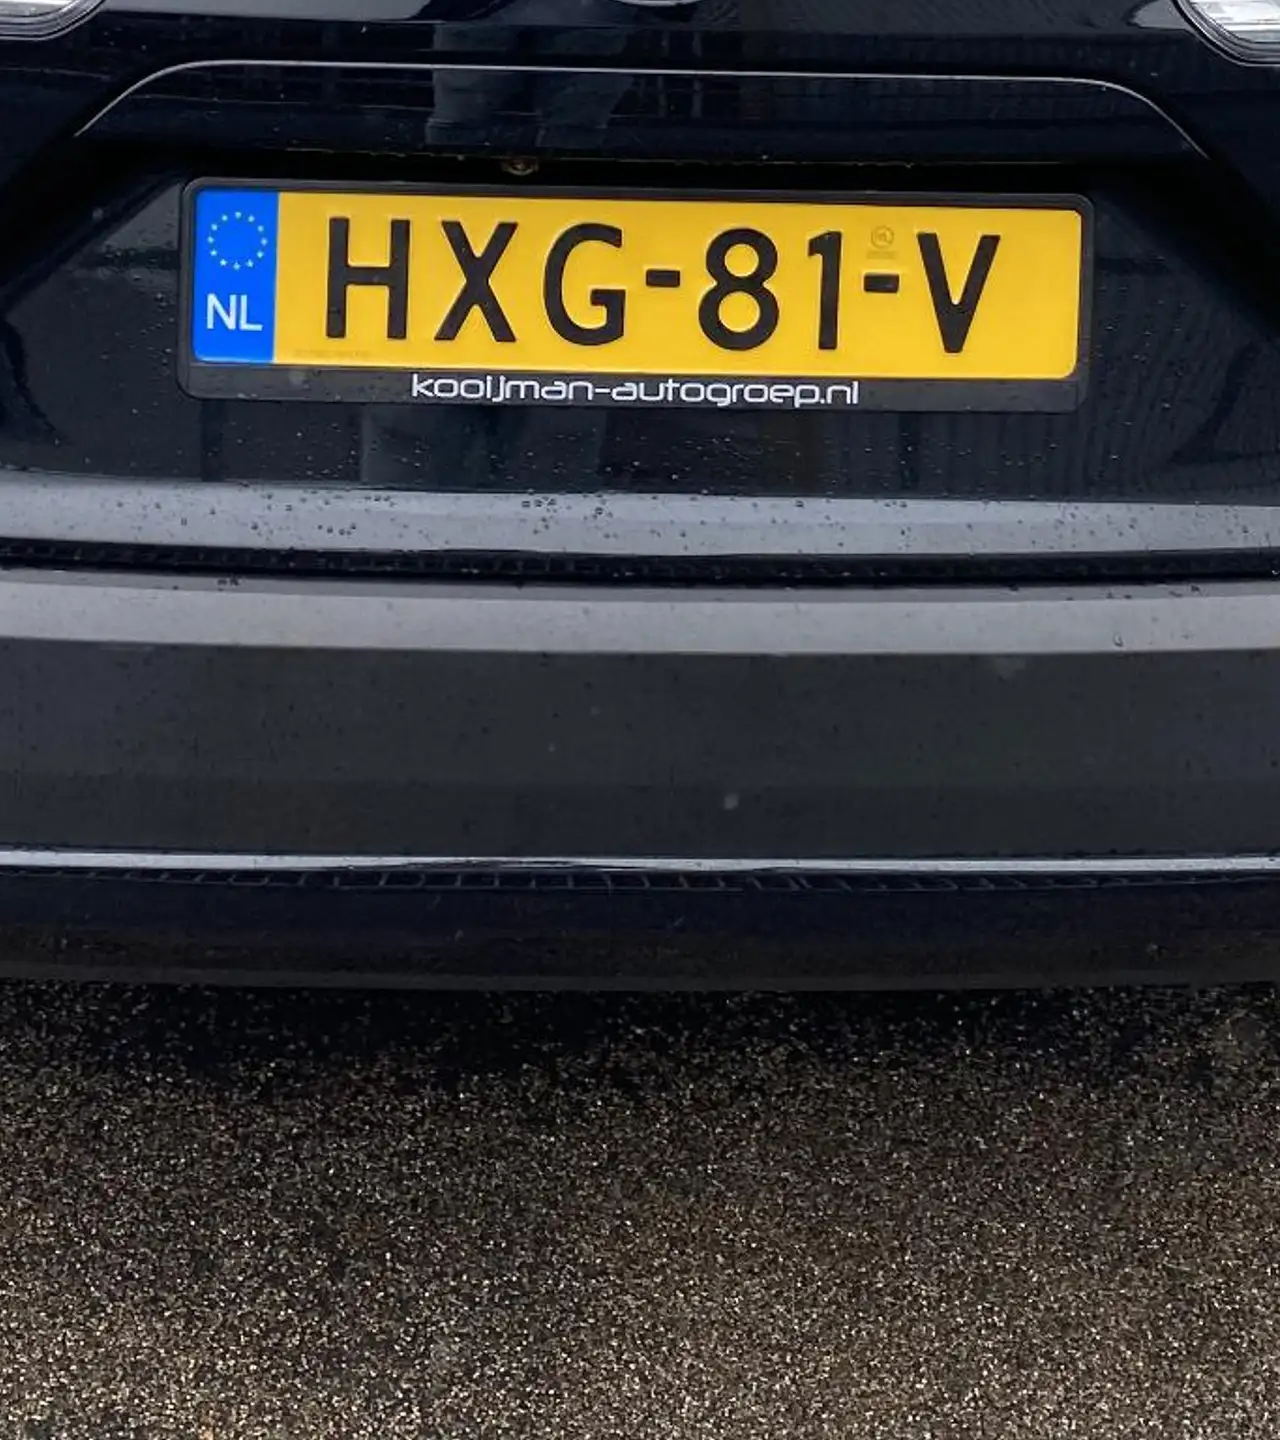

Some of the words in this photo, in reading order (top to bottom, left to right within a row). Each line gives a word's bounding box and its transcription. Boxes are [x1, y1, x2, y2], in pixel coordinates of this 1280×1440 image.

[326, 216, 1001, 354] HXG-81-V
[206, 293, 263, 331] NL
[411, 373, 859, 408] kooijman-autogroep.nl
